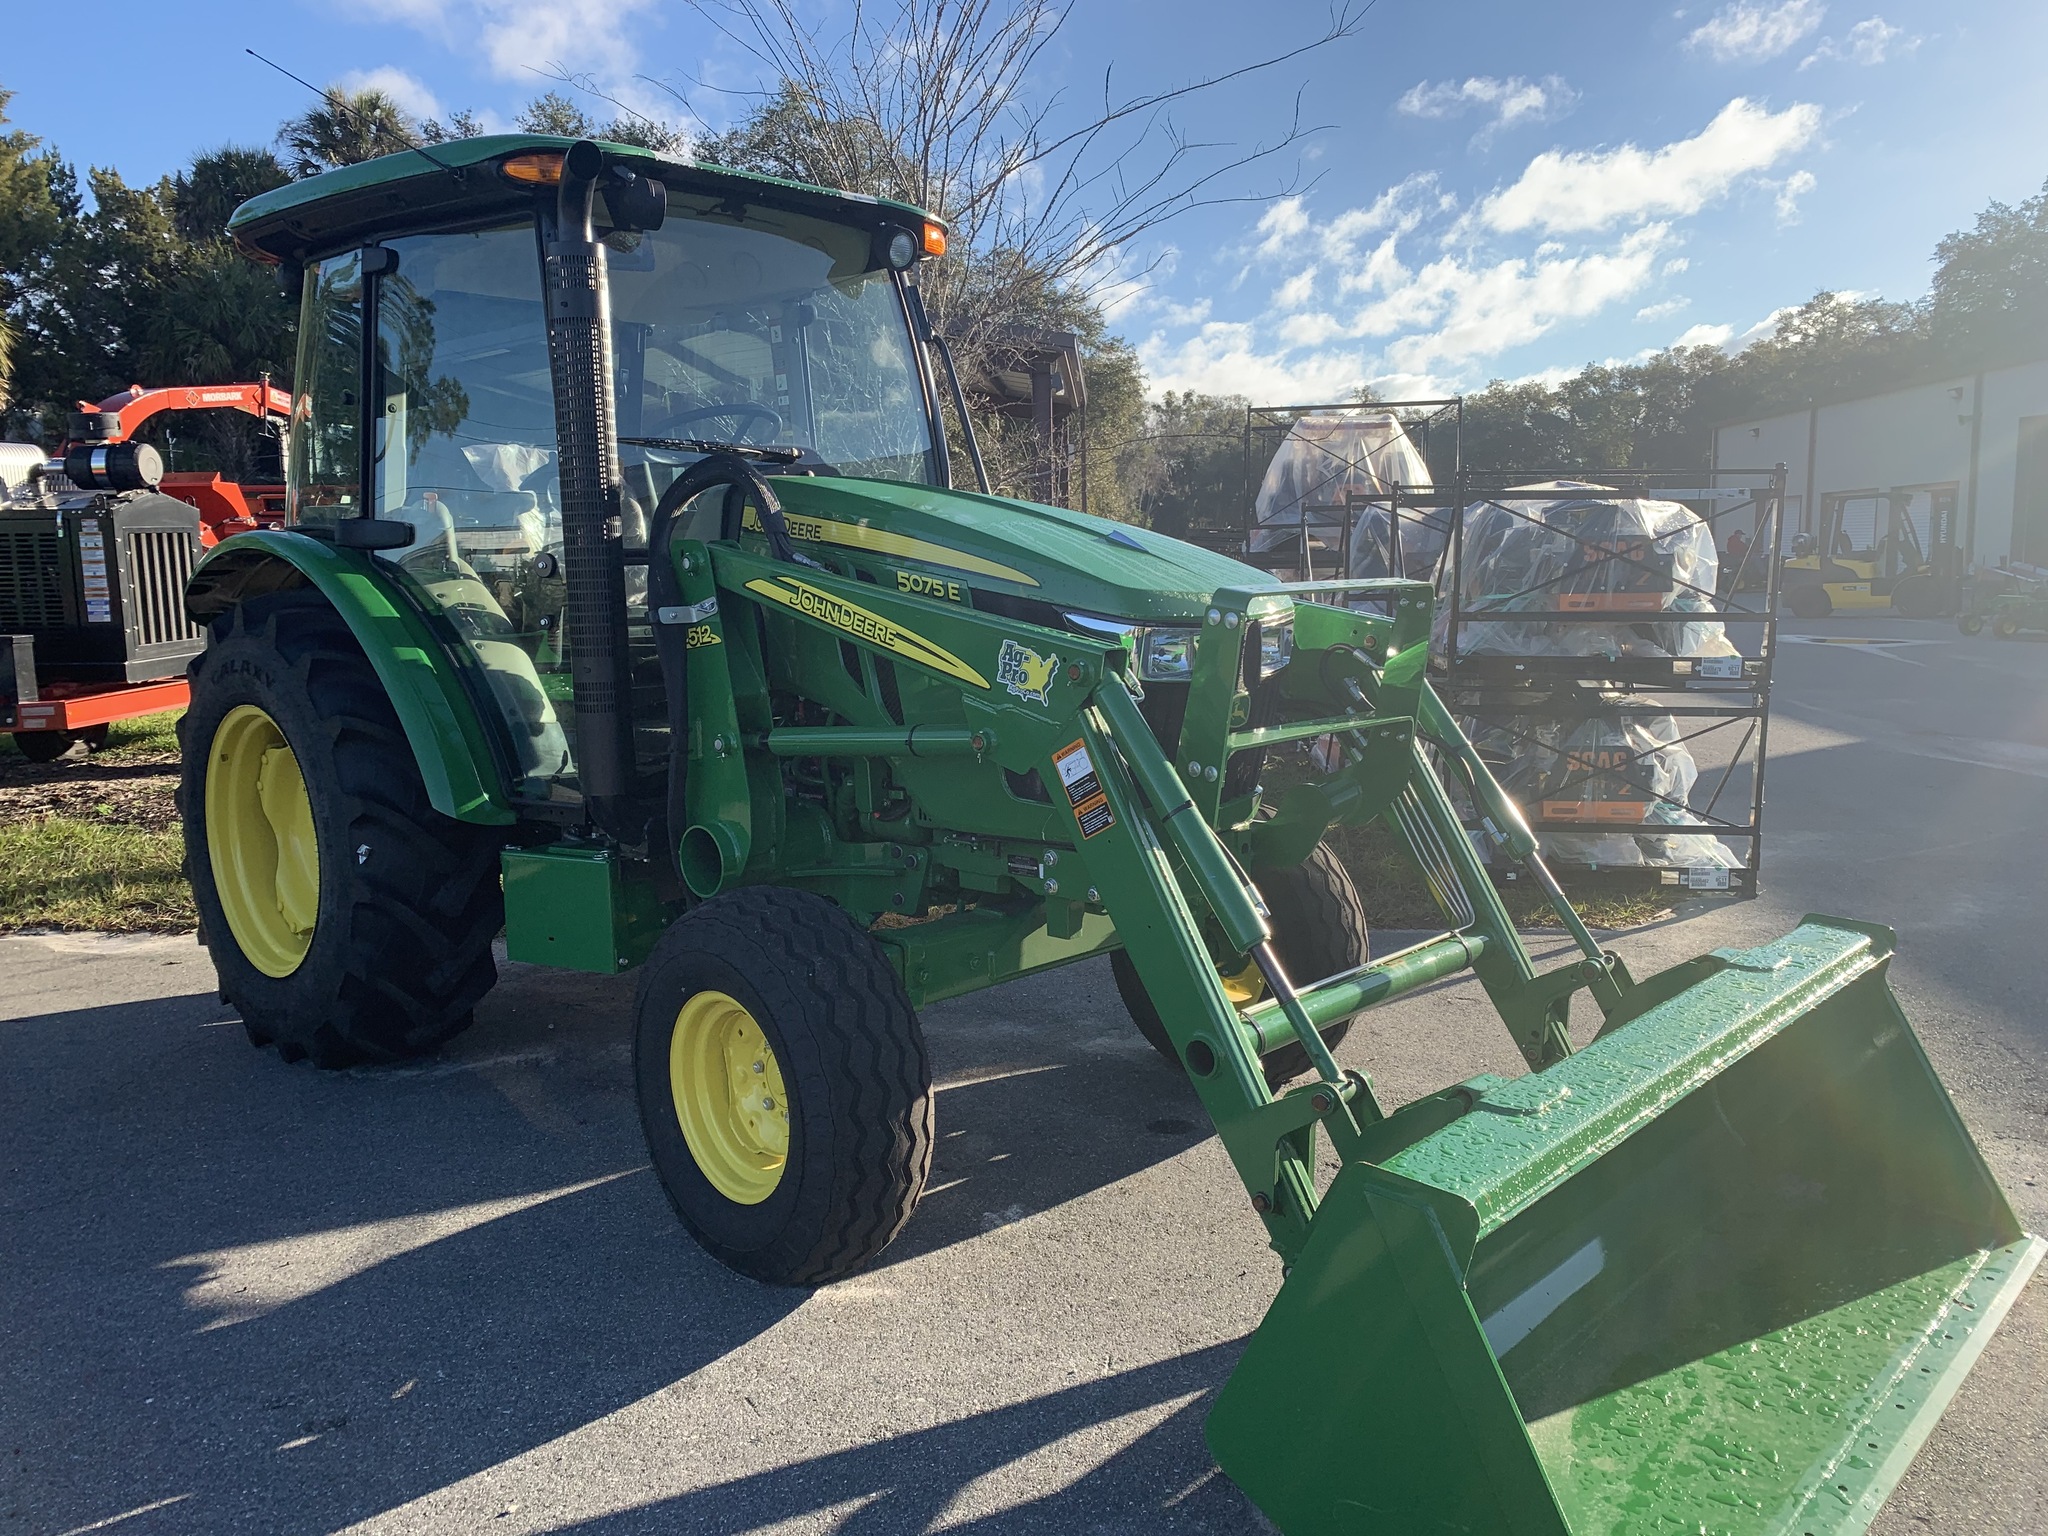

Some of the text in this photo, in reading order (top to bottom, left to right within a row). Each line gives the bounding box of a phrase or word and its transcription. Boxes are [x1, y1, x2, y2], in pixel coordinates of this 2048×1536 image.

[202, 391, 243, 402] MORBARK
[1939, 510, 1949, 544] HYUNDAI
[896, 570, 961, 602] 5075 E
[790, 586, 897, 646] JOHN DEERE
[687, 624, 712, 647] 512
[1002, 643, 1030, 668] Ag-
[1000, 661, 1029, 684] Pro
[1061, 742, 1081, 757] WARNING
[1083, 797, 1104, 812] WARNING
